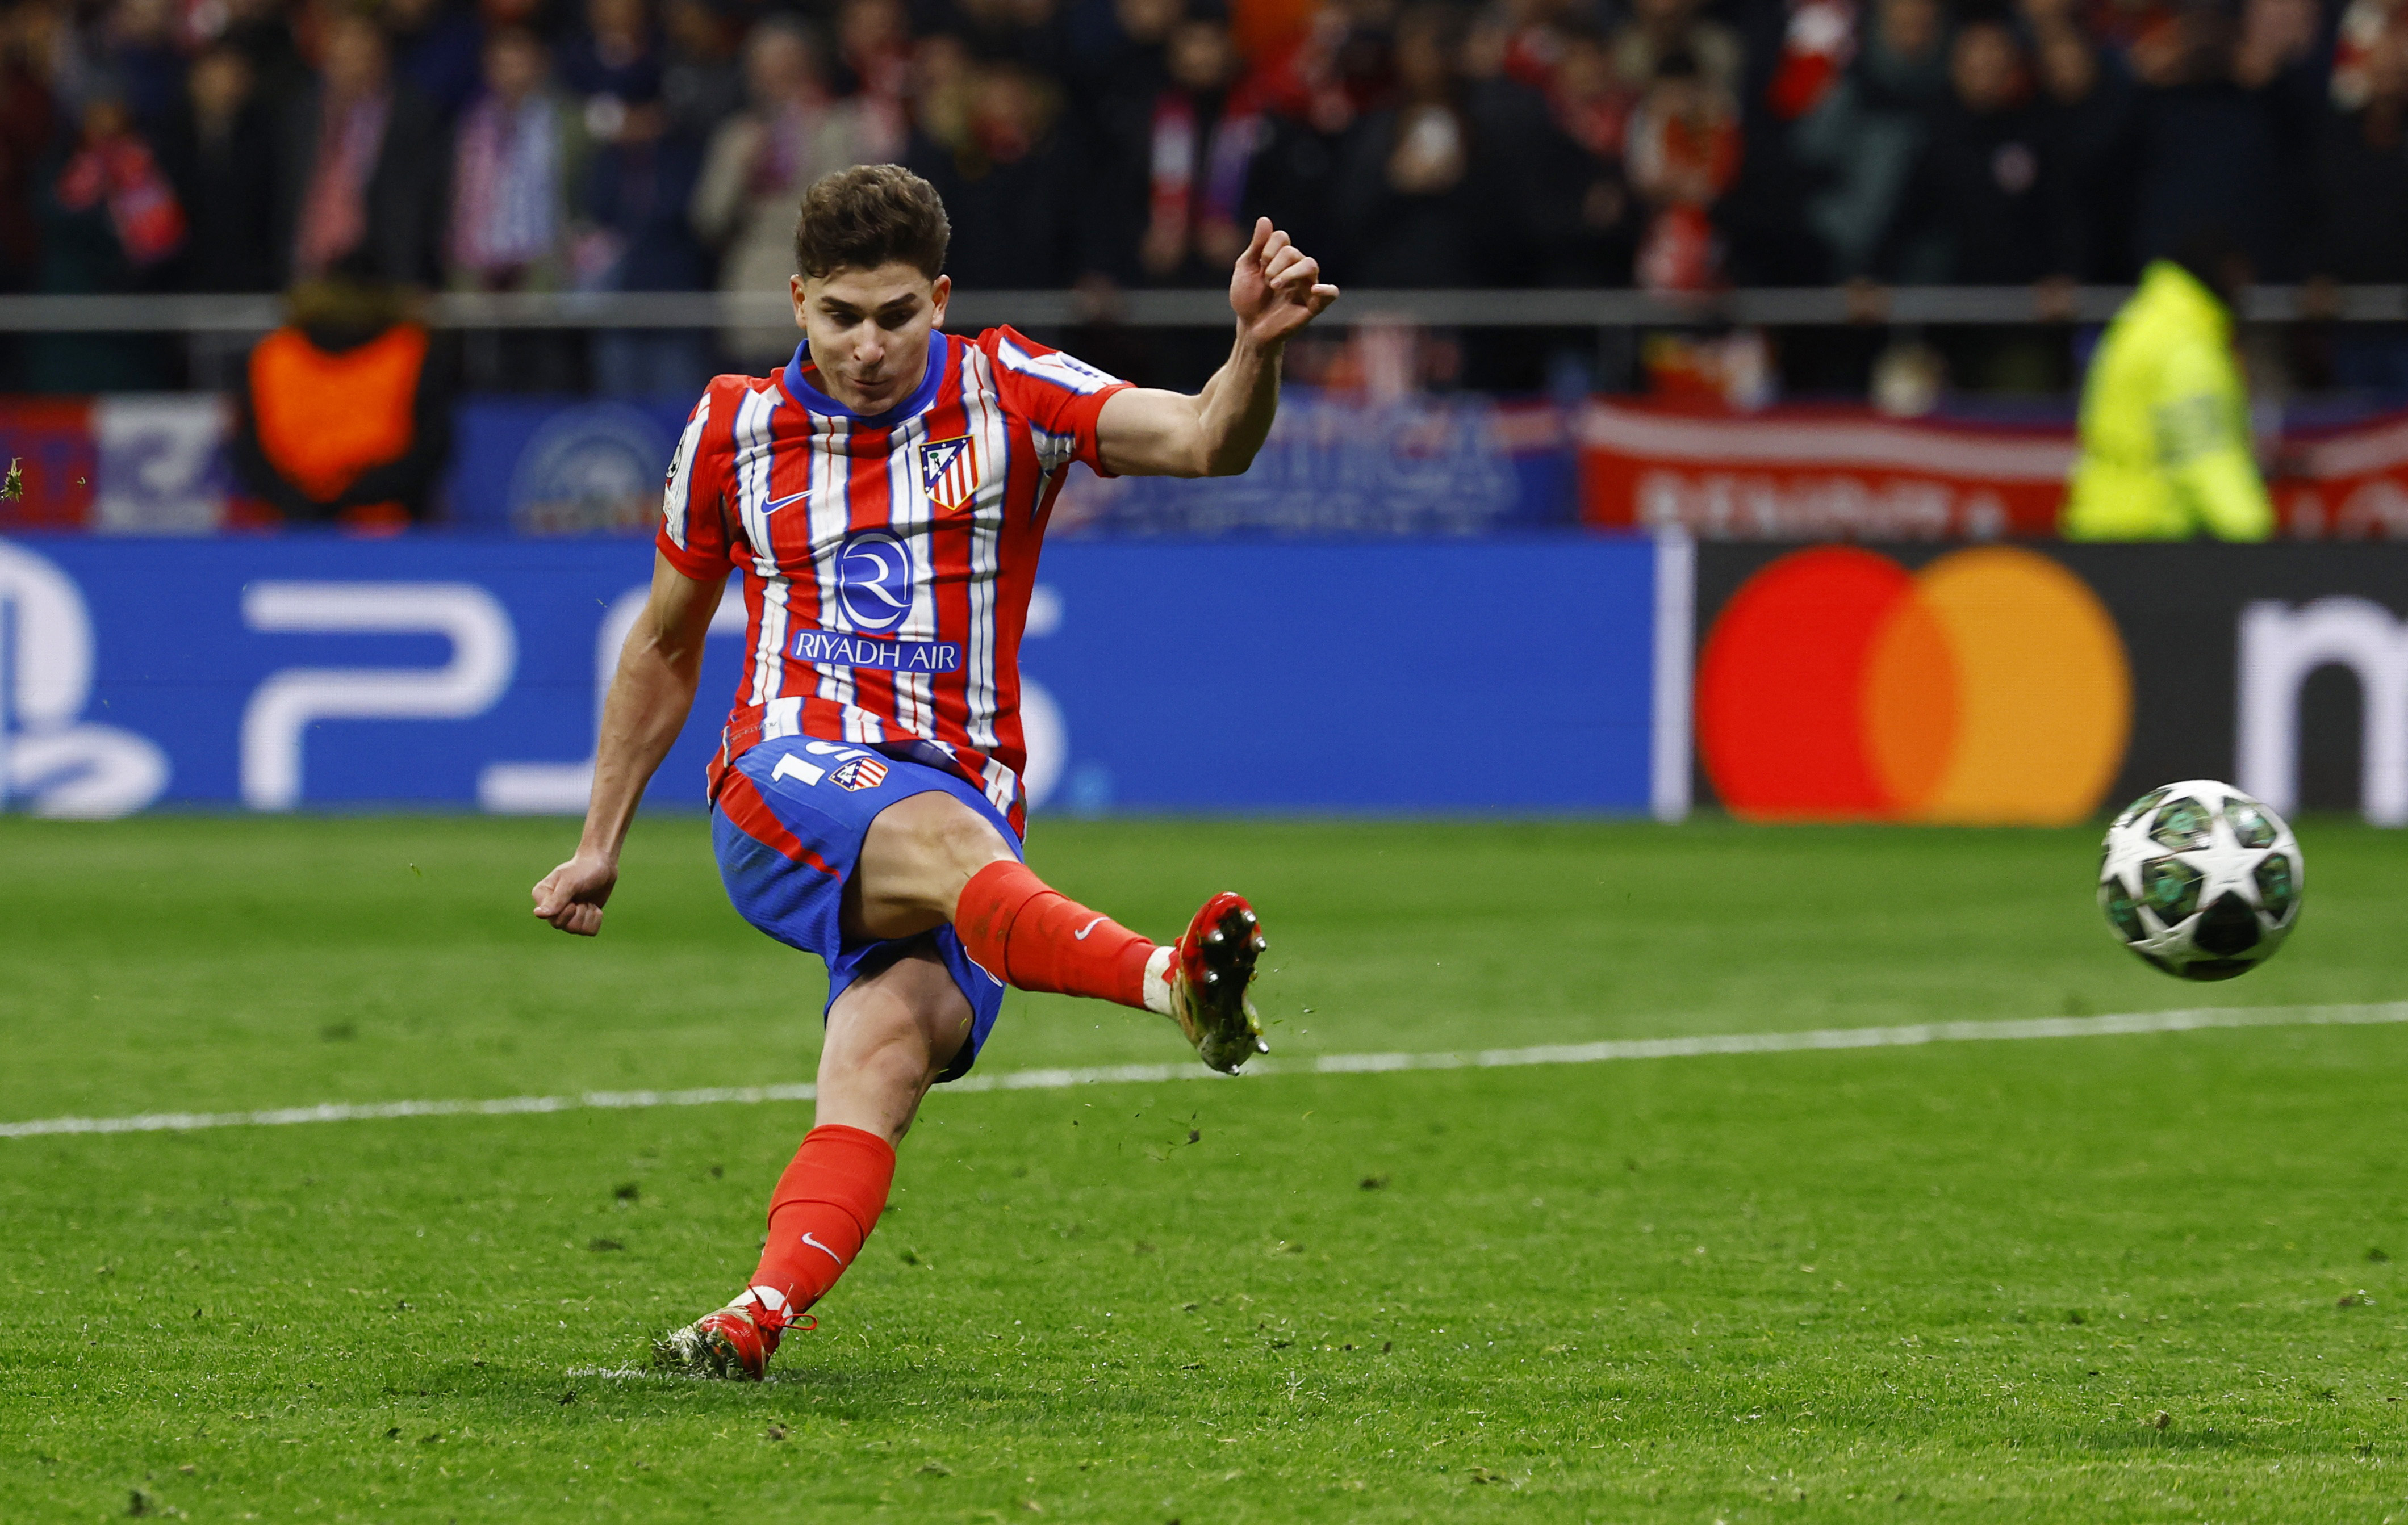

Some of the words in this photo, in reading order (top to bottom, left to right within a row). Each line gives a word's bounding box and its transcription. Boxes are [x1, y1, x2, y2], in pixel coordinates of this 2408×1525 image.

[239, 581, 1069, 815] PS
[796, 632, 900, 667] RIYADH
[909, 645, 956, 669] AIR
